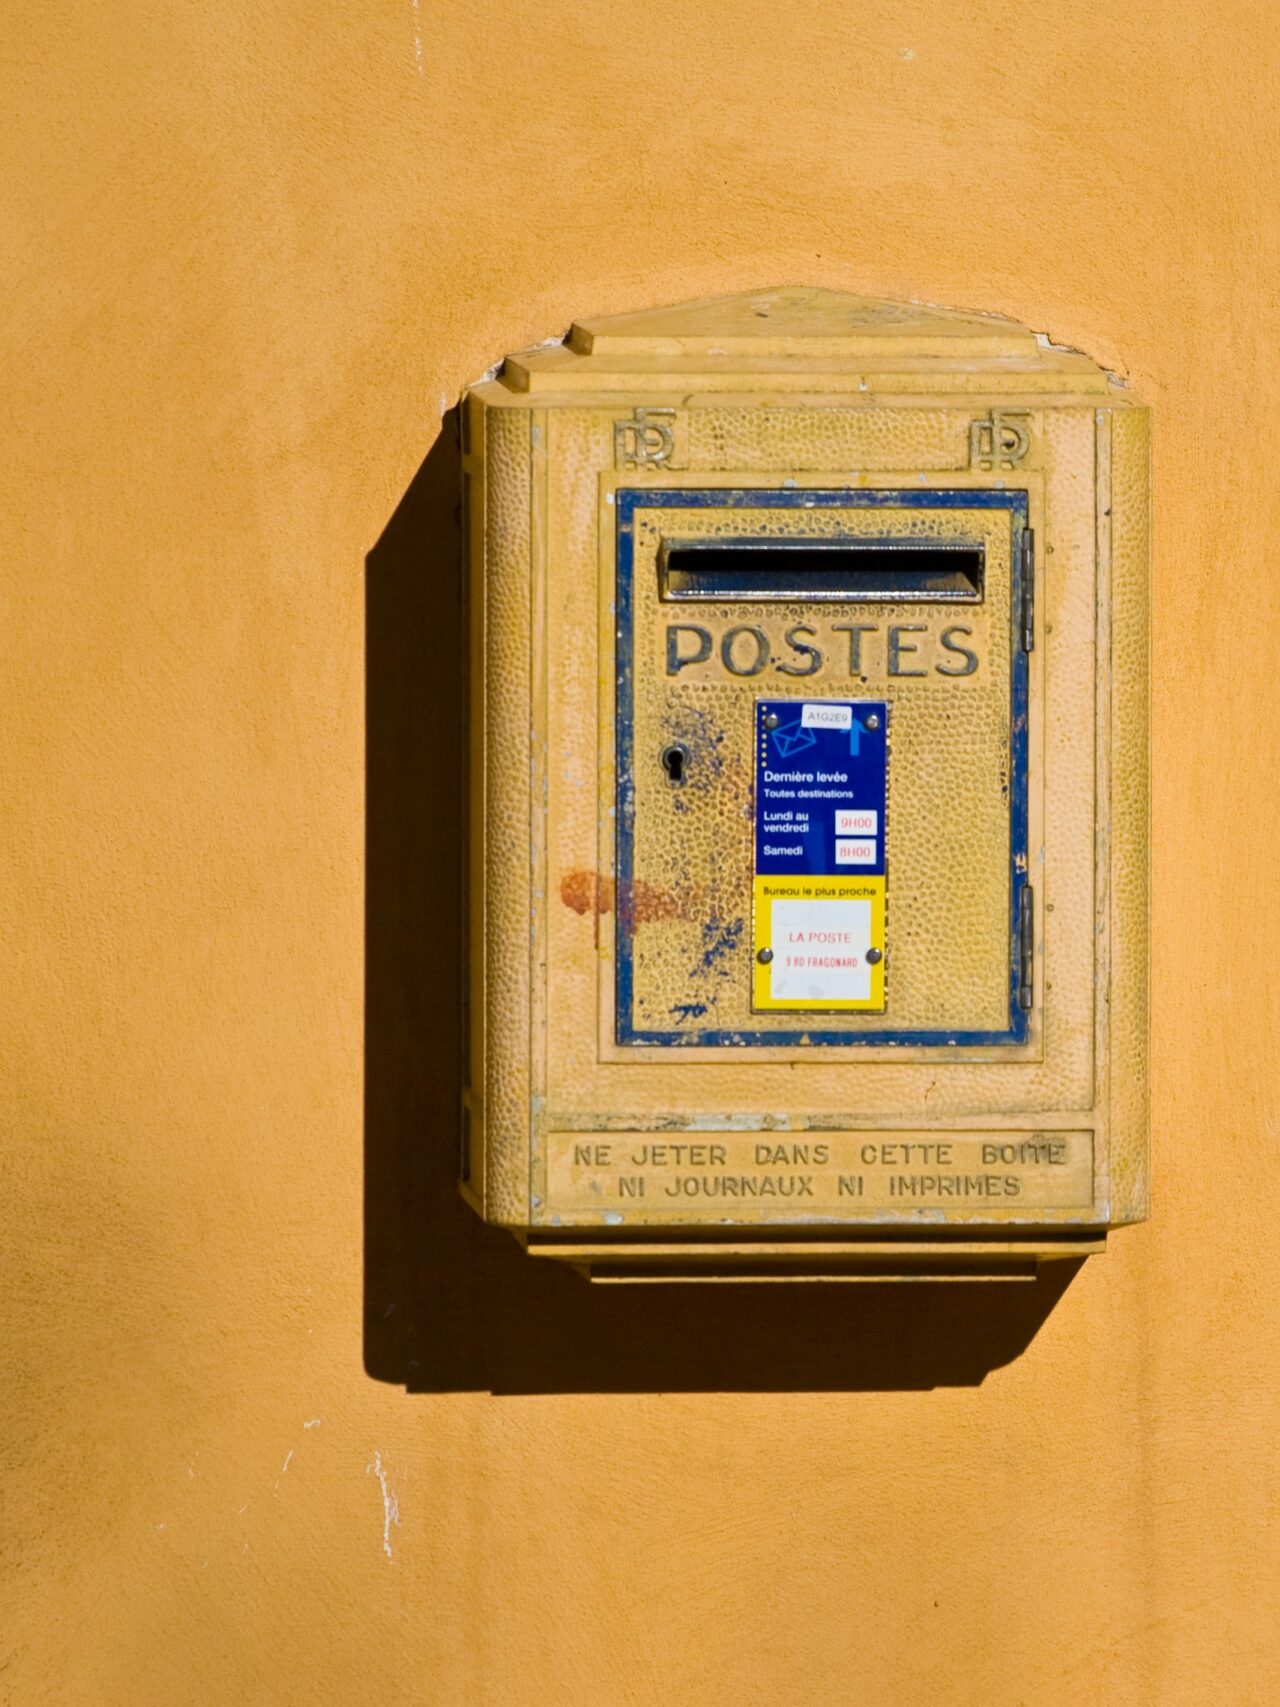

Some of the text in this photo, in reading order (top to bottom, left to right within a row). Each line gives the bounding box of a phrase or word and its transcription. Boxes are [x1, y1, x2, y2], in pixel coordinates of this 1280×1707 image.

[666, 624, 980, 677] POSTES
[807, 711, 848, 723] A1G2E9
[763, 770, 848, 782] Dernière levée
[764, 788, 854, 798] Toutes destinations
[763, 810, 809, 821] Lundi au
[763, 822, 809, 833] vendredi
[841, 817, 872, 828] 9H00
[763, 844, 803, 856] Samedi
[839, 846, 871, 858] 8H00
[763, 886, 877, 897] Bureau le plus proche
[789, 932, 852, 944] LA POSTE
[807, 956, 858, 968] FRAGONARD
[574, 1144, 1067, 1167] NE JETER DANS CETTE BOITE
[618, 1176, 1021, 1198] NI JOURNAUX NI IMPRIMES
